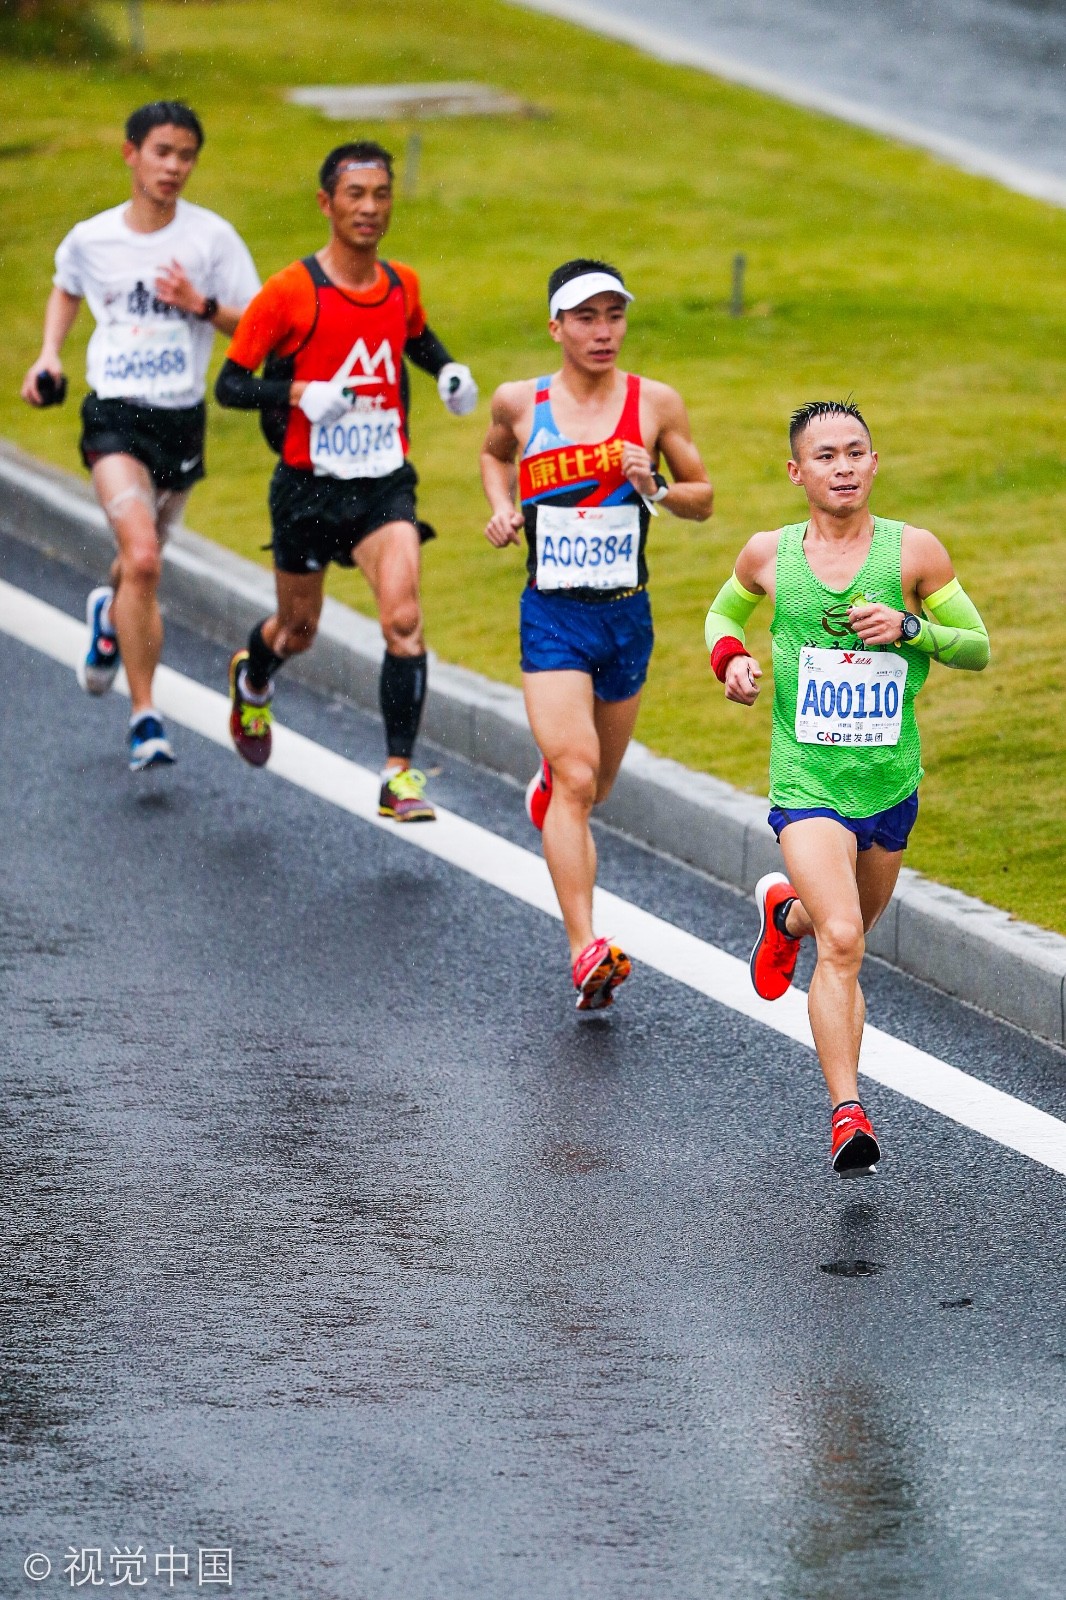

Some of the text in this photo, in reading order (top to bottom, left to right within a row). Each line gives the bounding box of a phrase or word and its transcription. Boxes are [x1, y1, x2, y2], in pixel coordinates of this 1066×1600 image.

[528, 439, 625, 490] 康比特
[542, 534, 633, 568] A00384
[801, 679, 899, 719] A00110
